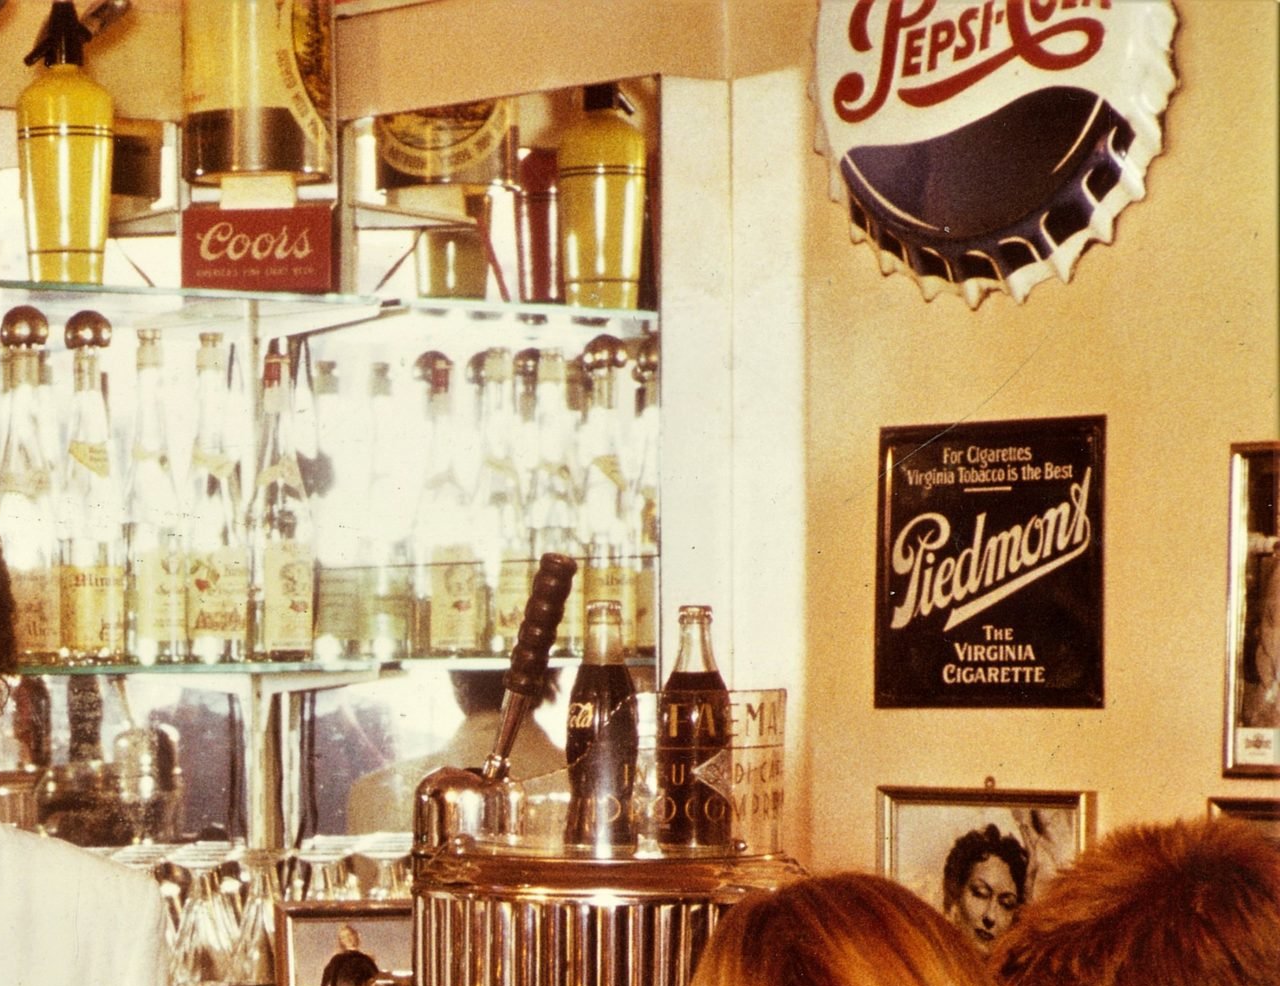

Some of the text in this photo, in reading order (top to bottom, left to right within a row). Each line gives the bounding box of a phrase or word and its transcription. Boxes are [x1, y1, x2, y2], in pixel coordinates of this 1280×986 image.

[833, 0, 1112, 122] PEPSI-C
[196, 222, 313, 261] Coors
[943, 445, 1033, 468] For Cigarettes
[907, 461, 1074, 490] Virginia Tobacco is the Best
[891, 466, 1091, 630] Piedmont
[954, 642, 1036, 661] VIRGINIA
[942, 663, 1045, 684] CIGARETTE
